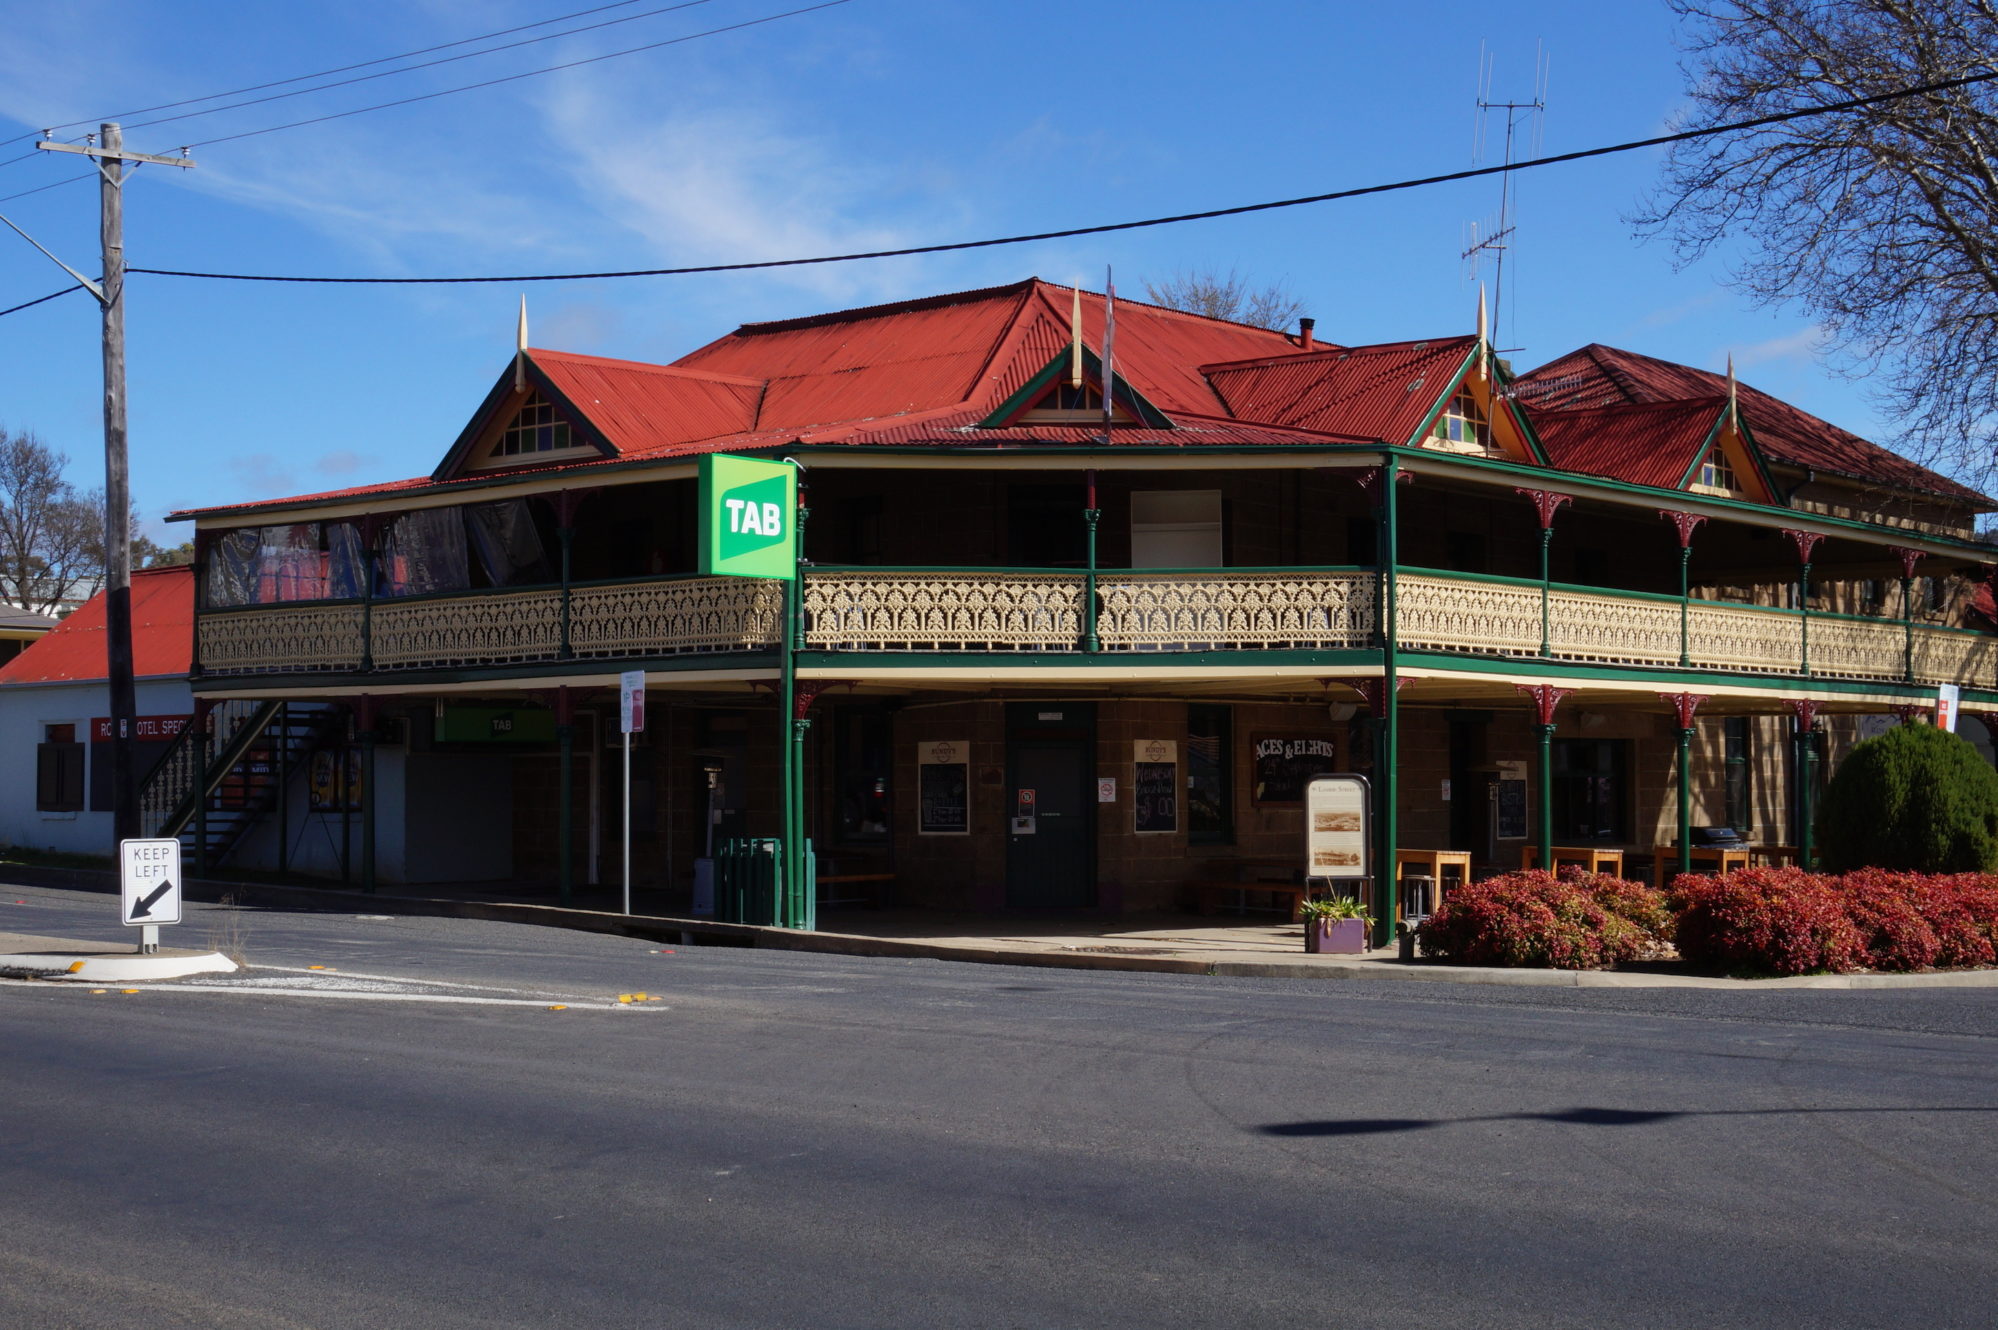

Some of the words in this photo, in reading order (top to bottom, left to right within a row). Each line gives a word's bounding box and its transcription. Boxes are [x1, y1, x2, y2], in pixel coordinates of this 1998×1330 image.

[726, 499, 781, 536] TAB
[137, 721, 158, 735] OTEL
[491, 719, 512, 731] TAB
[1256, 738, 1284, 760] ACES
[1284, 743, 1294, 760] &
[133, 847, 170, 861] KEEP
[135, 864, 168, 878] LEFT
